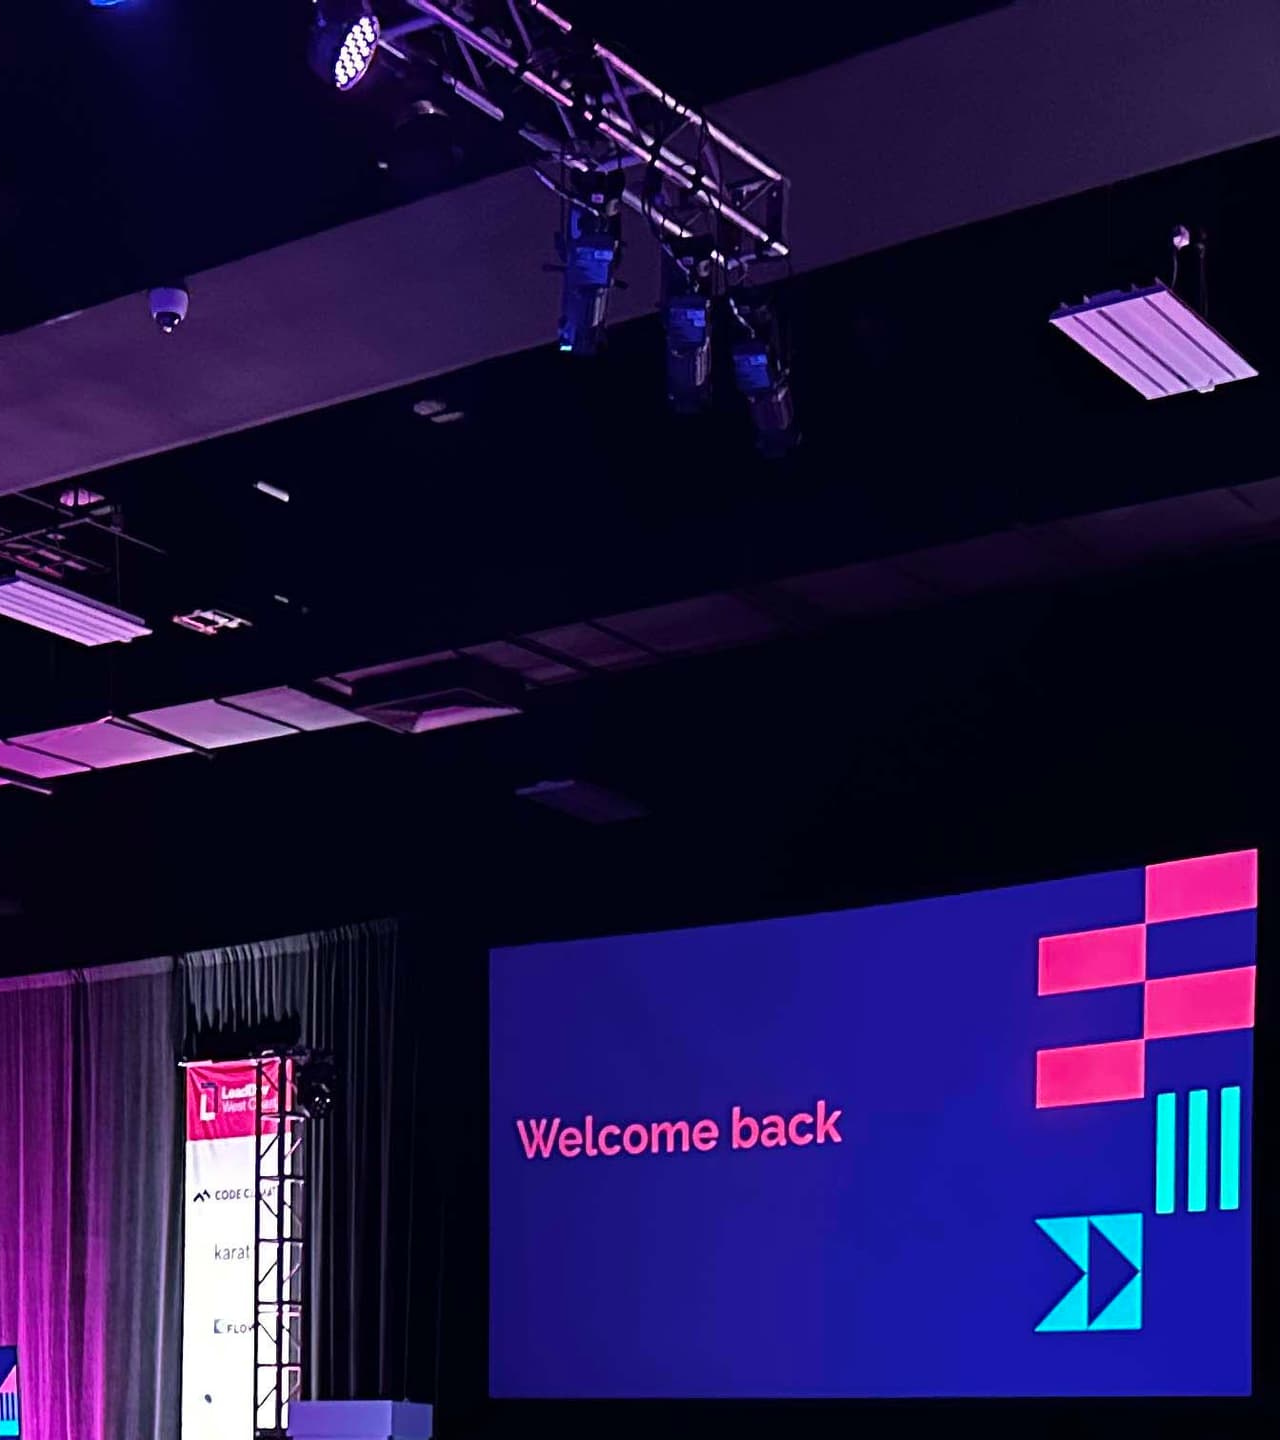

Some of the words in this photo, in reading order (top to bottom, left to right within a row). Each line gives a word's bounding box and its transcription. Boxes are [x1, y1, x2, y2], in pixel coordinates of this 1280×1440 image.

[221, 1083, 270, 1100] LeadDv
[516, 1115, 720, 1159] Welcome
[732, 1100, 843, 1150] back
[215, 1189, 241, 1201] CODE
[214, 1243, 250, 1261] karat
